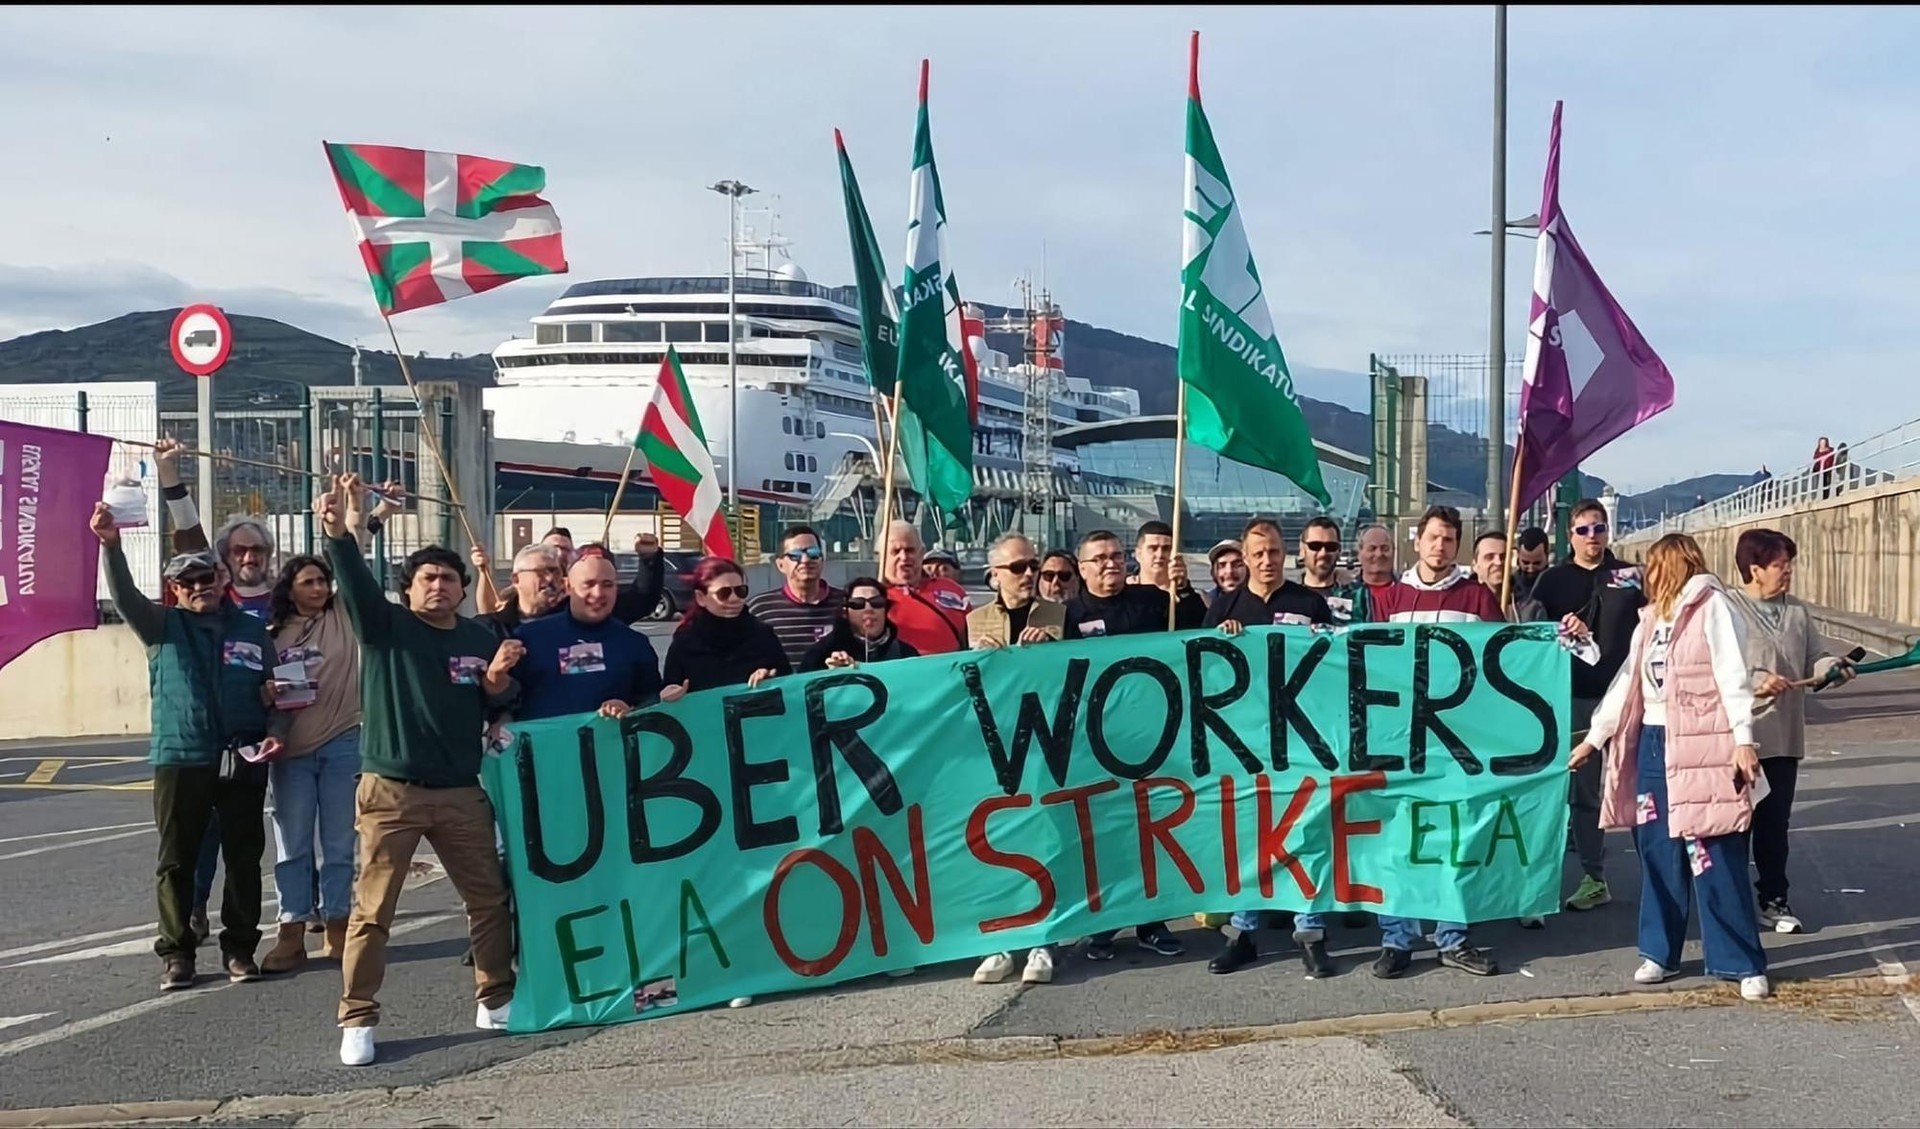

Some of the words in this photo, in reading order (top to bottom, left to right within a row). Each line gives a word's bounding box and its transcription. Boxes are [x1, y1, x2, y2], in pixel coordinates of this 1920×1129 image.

[515, 673, 904, 884] UBER
[961, 624, 1559, 794] WORKERS
[1409, 795, 1529, 868] ELA
[555, 879, 731, 1004] ELA
[763, 803, 935, 977] ON
[965, 771, 1387, 935] STRIKE
